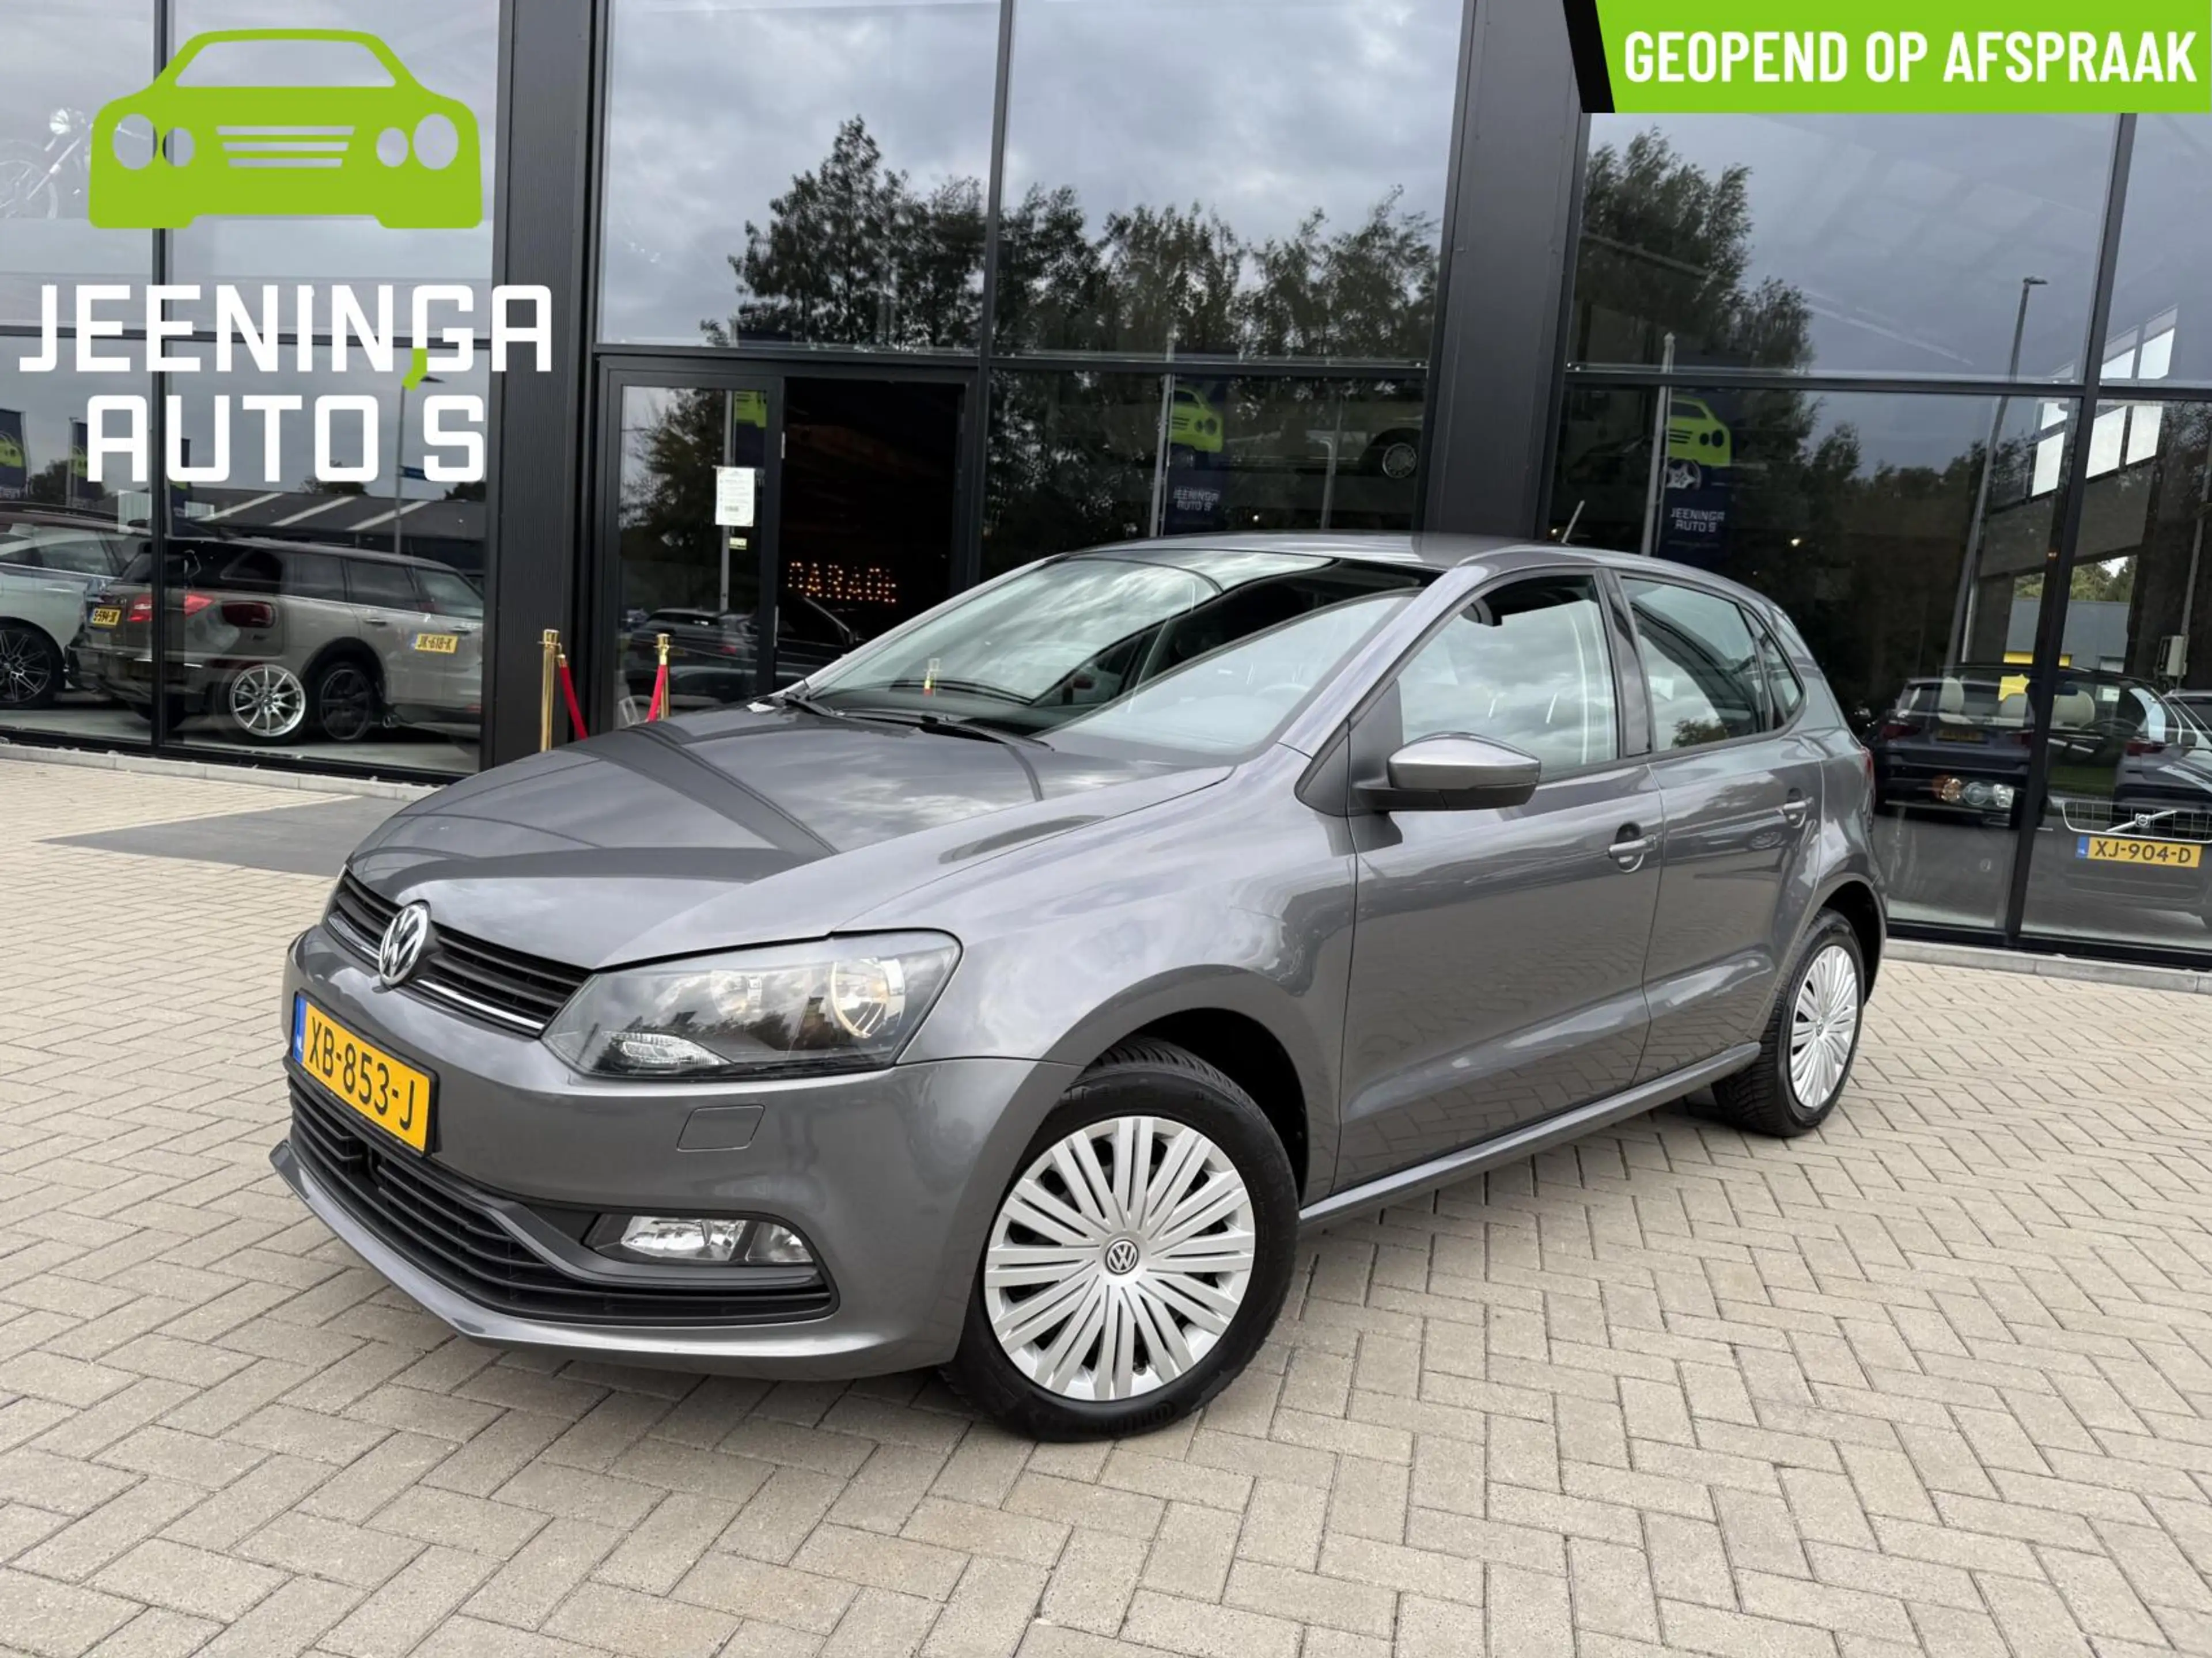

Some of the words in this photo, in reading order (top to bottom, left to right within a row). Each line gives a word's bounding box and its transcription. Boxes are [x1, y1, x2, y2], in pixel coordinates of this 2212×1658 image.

[1176, 500, 1213, 512] AUTOS
[1670, 507, 1725, 521] JEENINGA
[1675, 519, 1717, 533] AUTOS
[2095, 840, 2191, 863] XJ-904-D
[309, 1016, 415, 1130] XB-853-J
